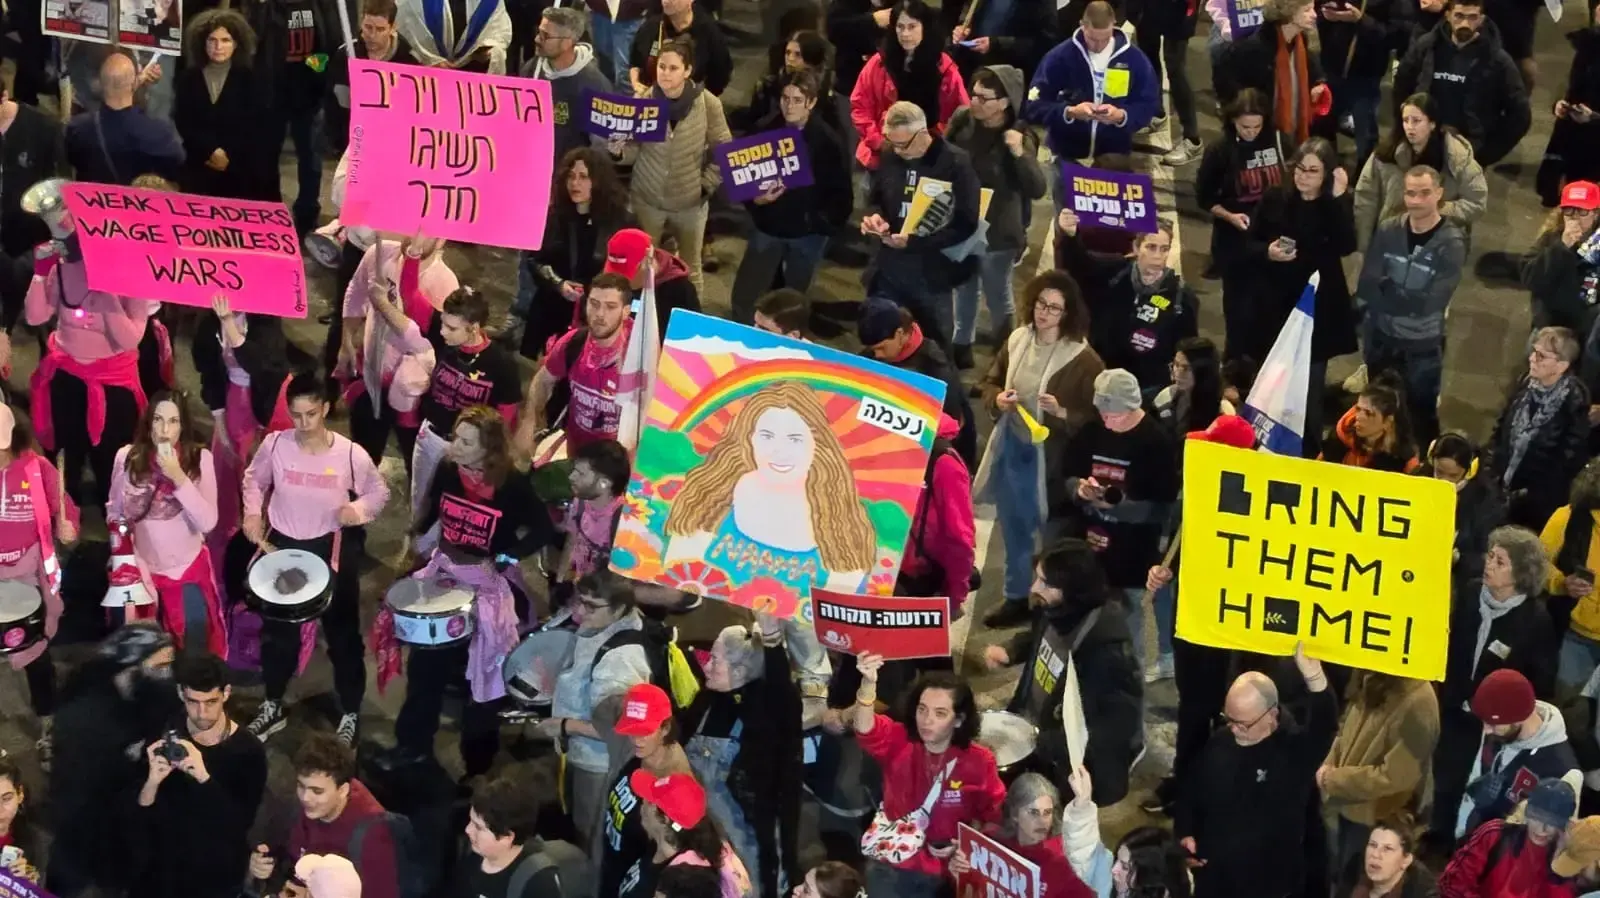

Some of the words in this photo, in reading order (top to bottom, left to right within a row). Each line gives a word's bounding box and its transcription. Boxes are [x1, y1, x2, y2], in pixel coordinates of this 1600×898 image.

[1237, 9, 1265, 27] לום
[360, 69, 438, 114] ויריב
[457, 81, 543, 129] גדעון
[592, 97, 636, 117] עסקה
[638, 107, 659, 119] כן,
[590, 110, 634, 131] שלום
[635, 120, 658, 133] כן,
[409, 126, 494, 177] תשיגו
[726, 142, 773, 167] עסקה
[777, 137, 795, 157] כן,
[732, 160, 778, 185] שלום
[781, 155, 800, 176] כן,
[1073, 176, 1119, 197] עסקה
[1123, 184, 1143, 200] כן,
[76, 191, 160, 214] WEAK
[165, 198, 292, 228] LEADERS
[408, 180, 477, 223] חדר
[1074, 195, 1121, 214] שלום
[1124, 201, 1146, 219] כן,
[78, 217, 167, 243] WAGE
[172, 224, 296, 255] POINTLESS
[146, 255, 243, 291] WARS
[863, 404, 922, 435] נעמה
[1217, 470, 1411, 539] BRING
[1216, 531, 1382, 596] THEM
[820, 602, 872, 625] תקווה
[876, 611, 941, 625] דרושה:
[1218, 588, 1412, 664] HOME!
[970, 840, 1027, 898] אמא
